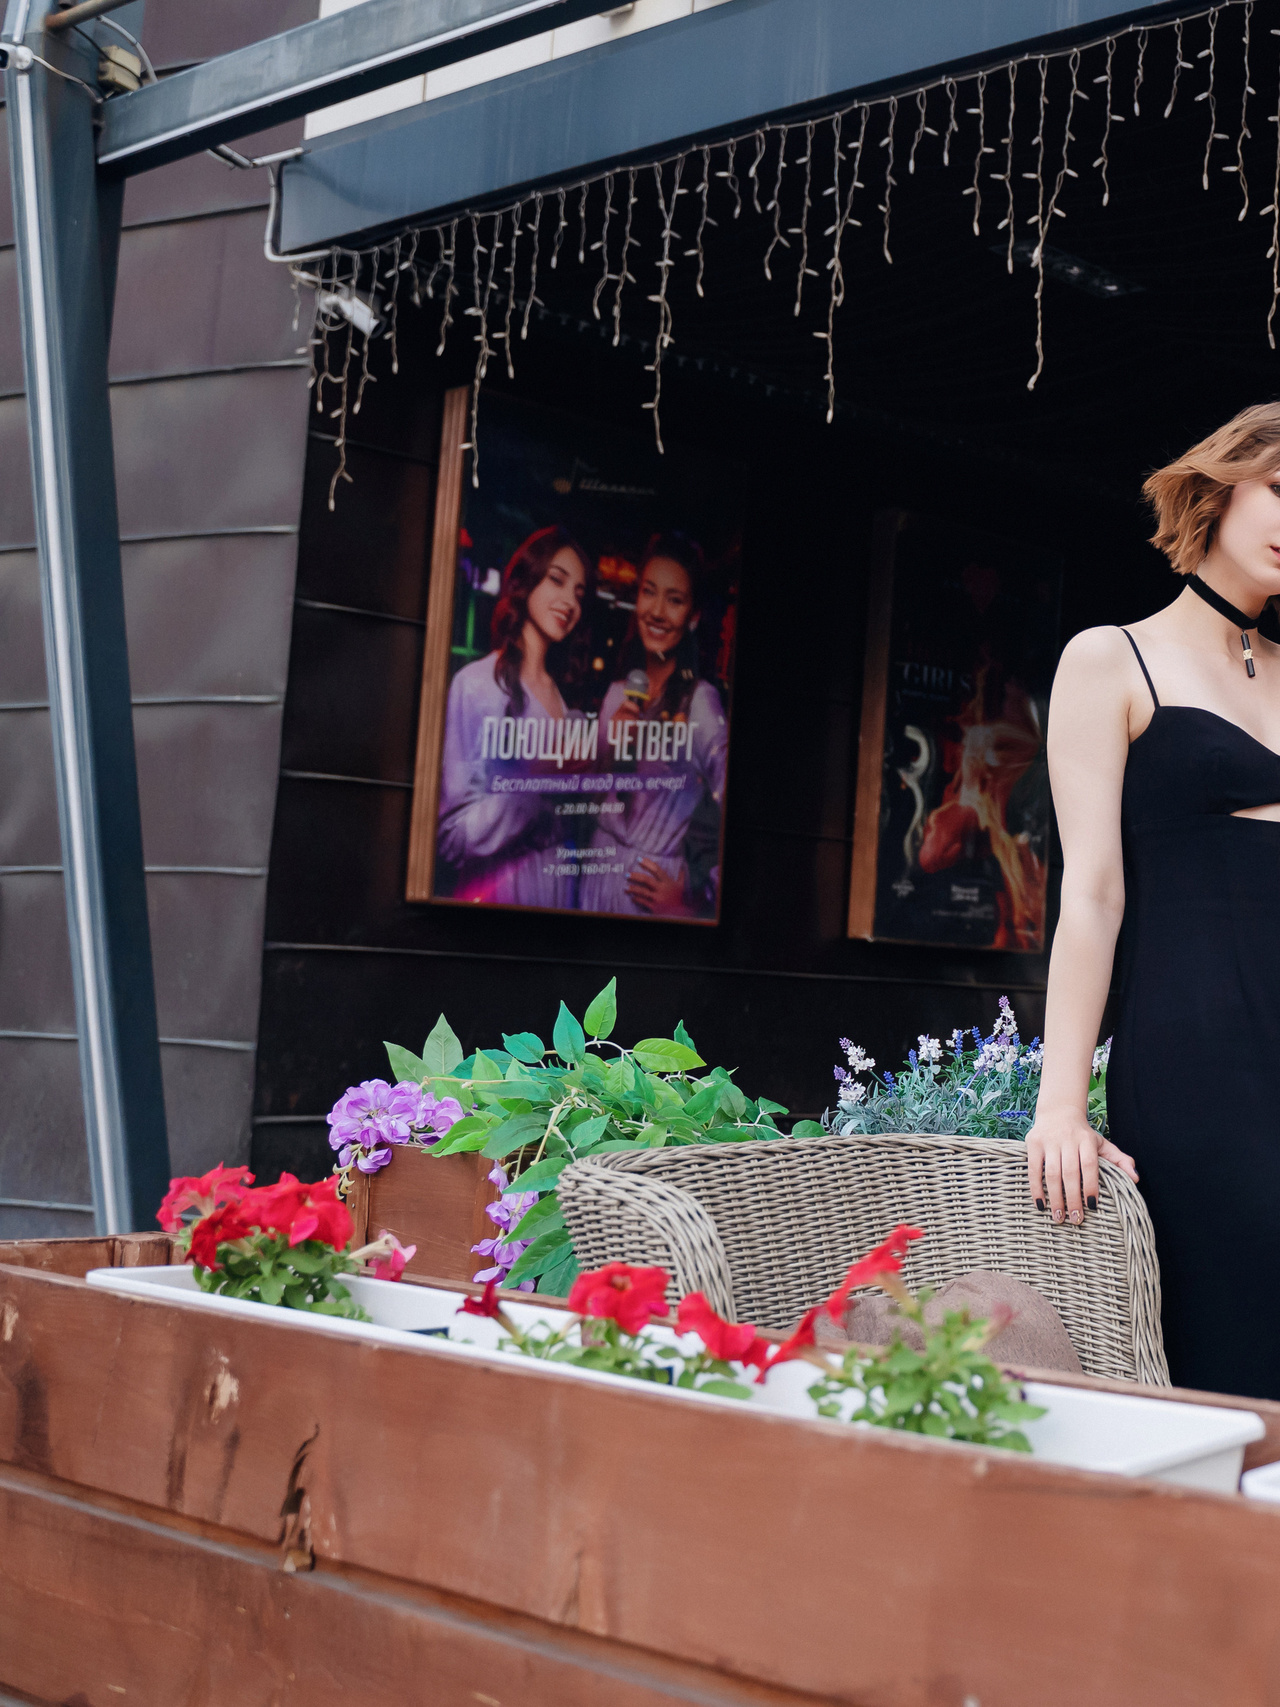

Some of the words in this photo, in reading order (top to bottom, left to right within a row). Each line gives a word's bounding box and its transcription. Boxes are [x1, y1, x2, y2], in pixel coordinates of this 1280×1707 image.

[481, 712, 600, 769] ПОЮЩИЙ
[607, 718, 699, 762] ЧЕТВЕРГ
[491, 774, 581, 793] Бесплатный
[581, 773, 613, 791] вход
[615, 776, 643, 791] весь
